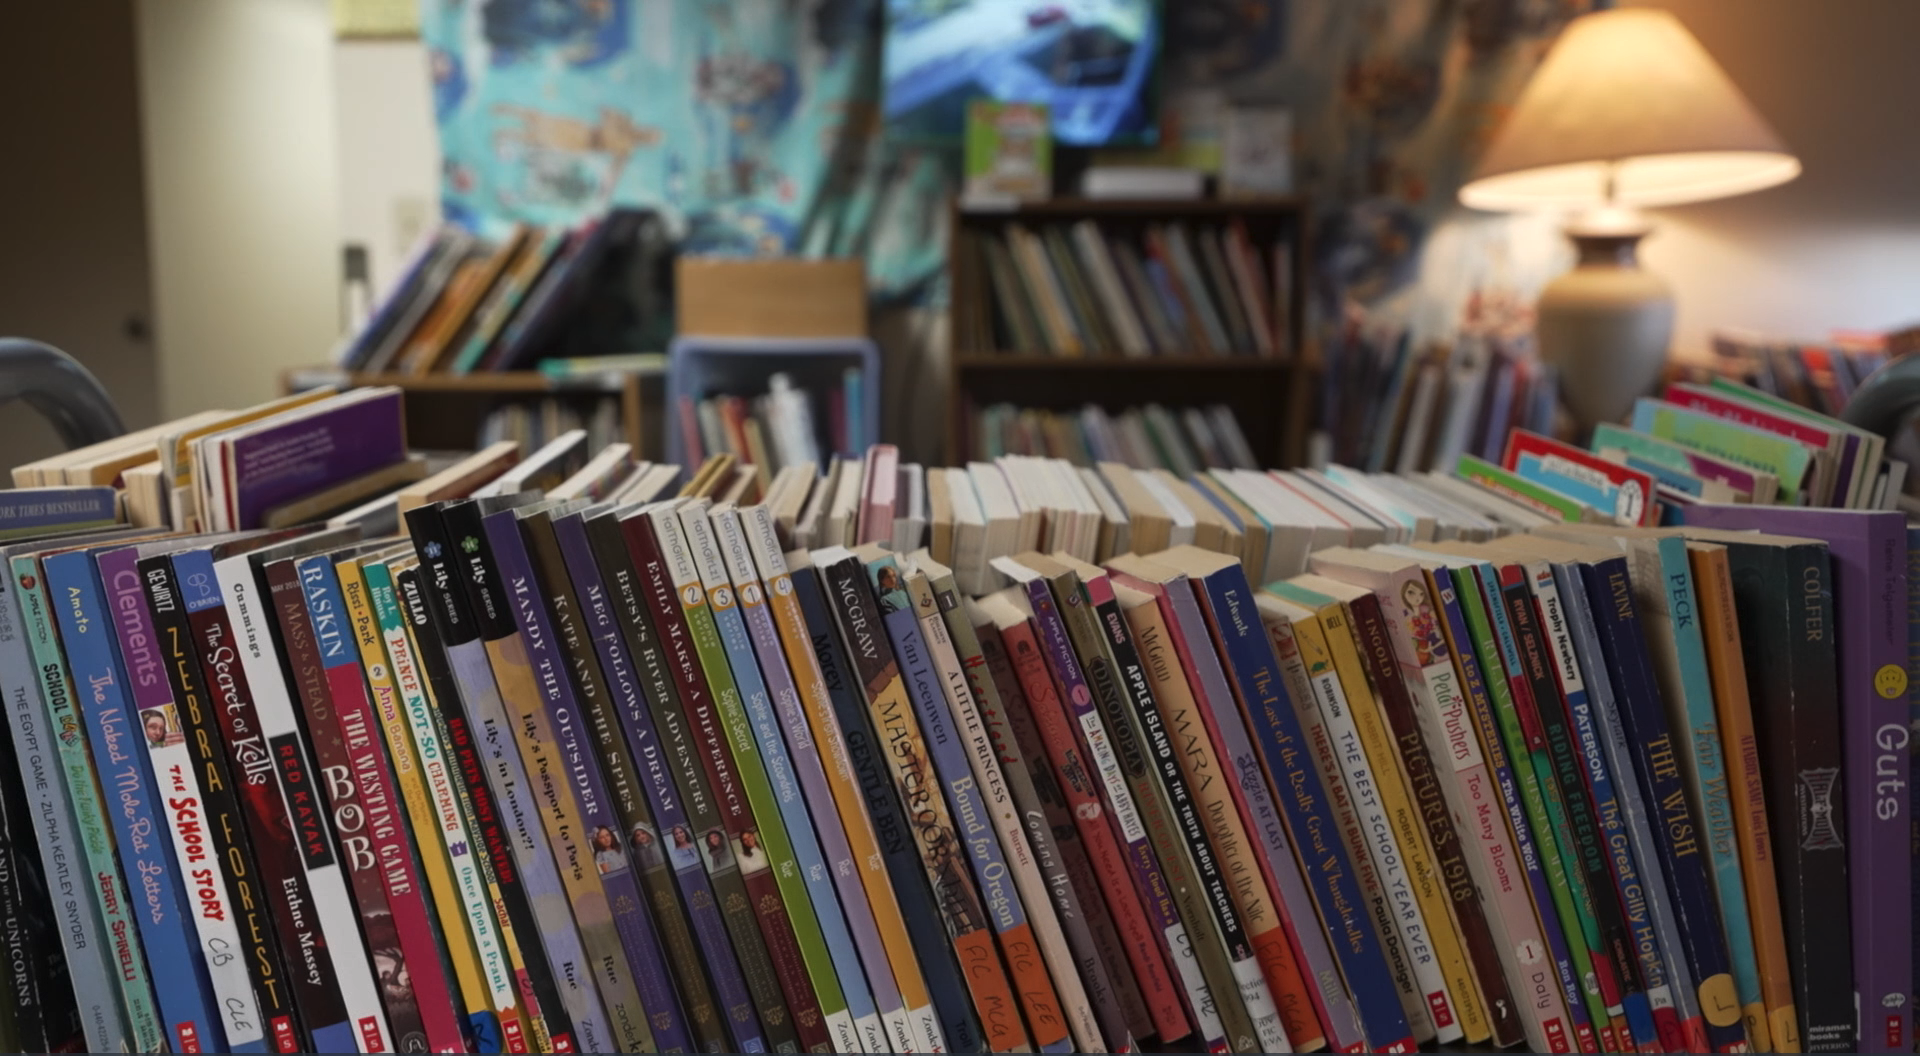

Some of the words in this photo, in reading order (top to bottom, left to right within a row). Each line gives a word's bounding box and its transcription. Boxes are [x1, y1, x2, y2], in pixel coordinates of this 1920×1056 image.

[19, 504, 44, 518] TIMES
[49, 500, 101, 515] BESTSELLER
[147, 569, 175, 613] GEWIRTZ
[433, 563, 448, 590] Lily
[470, 558, 486, 585] Lily
[1609, 572, 1634, 622] LEVINE
[68, 587, 89, 633] Amato
[114, 570, 156, 686] Clements
[233, 583, 261, 658] Cummings
[303, 566, 344, 658] RASKIN
[347, 582, 363, 610] Rissi
[358, 617, 376, 646] Park
[403, 580, 428, 626] ZULLO
[443, 593, 459, 624] SERIES
[481, 588, 496, 620] SERIES
[838, 578, 878, 660] MCGRAW
[1106, 612, 1126, 644] EVANS
[1224, 589, 1248, 638] Edwards
[1326, 616, 1342, 630] BELL
[1670, 572, 1692, 630] PECK
[1803, 566, 1823, 642] COLFER
[812, 634, 844, 692] Morey
[1048, 616, 1064, 644] APPLE
[1059, 645, 1076, 680] FICTION
[1366, 618, 1392, 678] INGOLD
[1548, 597, 1562, 633] Trophy
[1558, 635, 1576, 680] Newbery
[14, 687, 28, 710] THE
[89, 668, 113, 704] The
[512, 576, 546, 651] MANDY
[539, 658, 562, 700] THE
[556, 708, 599, 815] OUTSIDER
[588, 585, 610, 627] MEG
[604, 632, 642, 722] FOLLOWS
[637, 728, 648, 740] A
[644, 746, 674, 812] DREAM
[616, 570, 648, 643] BETSY'S
[644, 648, 670, 704] RIVER
[664, 710, 708, 815] ADVENTURE
[647, 561, 674, 616] EMILY
[668, 623, 696, 683] MAKES
[690, 690, 700, 700] A
[696, 706, 742, 816] DIFFERENCE
[902, 631, 919, 666] Van
[913, 668, 948, 745] Leeuwen
[948, 671, 959, 681] A
[1252, 666, 1269, 697] The
[1322, 678, 1342, 718] ROBINSON
[20, 712, 38, 751] EGYPT
[374, 686, 396, 722] Anna
[390, 725, 412, 772] Banana
[554, 594, 580, 650] KATE
[574, 656, 596, 698] AND
[592, 704, 613, 745] THE
[606, 751, 636, 814] SPIES
[952, 684, 979, 732] LITTLE
[1094, 666, 1144, 770] DINOTOPIA
[1263, 697, 1282, 730] Last
[1432, 672, 1452, 710] Petal
[1443, 706, 1472, 761] Pushers
[1606, 700, 1626, 748] Skylark
[99, 708, 128, 765] Naked
[1171, 708, 1213, 792] MARA
[1274, 731, 1294, 746] of
[1280, 746, 1296, 770] the
[1310, 722, 1336, 776] THERE'S
[1574, 704, 1604, 782] PATERSON
[1694, 721, 1719, 768] Fair
[30, 755, 48, 790] GAME
[169, 765, 186, 792] THE
[848, 730, 885, 812] GENTLE
[878, 816, 904, 855] BEN
[973, 736, 1007, 804] PRINCESS
[1290, 770, 1314, 814] Really
[1328, 773, 1339, 786] A
[1332, 784, 1348, 811] BAT
[1648, 732, 1679, 784] THE
[1664, 789, 1699, 858] WISH
[1876, 723, 1909, 820] Guts
[41, 802, 60, 843] ZILPHA
[115, 766, 151, 854] Mole-Rat
[167, 627, 223, 792] ZEBRA
[220, 814, 279, 1008] FOREST
[280, 745, 302, 783] RED
[293, 791, 324, 856] KAYAK
[321, 765, 376, 872] BOB
[342, 708, 370, 750] THE
[356, 754, 394, 840] WESTING
[380, 844, 412, 896] GAME
[1126, 664, 1152, 708] APPLE
[1144, 710, 1171, 758] ISLAND
[1164, 762, 1176, 778] OR
[1172, 780, 1188, 802] THE
[1181, 804, 1200, 840] TRUTH
[1195, 843, 1216, 876] ABOUT
[1210, 880, 1237, 932] TEACHERS
[1237, 753, 1264, 804] Lizzie
[1258, 804, 1270, 819] AT
[1264, 821, 1284, 851] LAST
[1342, 812, 1353, 826] IN
[1550, 724, 1576, 785] RIDING
[1569, 794, 1602, 872] FREEDOM
[1704, 772, 1732, 857] Weather
[169, 798, 206, 863] SCHOOL
[951, 776, 985, 836] Bound
[968, 838, 990, 862] for
[983, 862, 1015, 928] Oregon
[1009, 828, 1030, 867] Burnett
[1306, 816, 1330, 855] Great
[1340, 730, 1362, 764] THE
[1354, 770, 1376, 808] BEST
[1371, 814, 1394, 876] SCHOOL
[1391, 877, 1416, 920] YEAR
[1406, 923, 1431, 965] EVER
[1348, 826, 1368, 860] BUNK
[1397, 808, 1416, 850] ROBERT
[1412, 854, 1433, 898] LAWSON
[1468, 774, 1481, 800] Too
[1476, 804, 1496, 842] Many
[1490, 844, 1512, 892] Blooms
[52, 846, 73, 896] KEATLEY
[138, 860, 164, 924] Letters
[808, 864, 822, 882] Rue
[838, 858, 851, 878] Rue
[1026, 810, 1054, 868] Coming
[1051, 873, 1074, 920] Home
[1360, 862, 1378, 893] FIVE
[1444, 857, 1472, 901] 1918
[192, 869, 224, 922] STORY
[1322, 856, 1364, 954] Whangdoodles
[66, 902, 86, 950] SNYDER
[98, 872, 120, 915] JERRY
[112, 920, 136, 982] SPINELLI
[282, 877, 304, 928] Eithne
[298, 932, 322, 986] Massey
[1374, 897, 1392, 934] Paula
[1388, 936, 1414, 994] Danziger
[6, 918, 31, 1006] UNICORNS
[563, 962, 578, 990] Rue
[603, 955, 618, 986] Rue
[1009, 942, 1033, 973] FIC
[1024, 991, 1058, 1026] LEE
[1319, 970, 1342, 1006] Mills
[1532, 972, 1552, 1009] Daly
[956, 1020, 972, 1048] Troll
[1810, 1024, 1851, 1034] miramax
[1810, 1032, 1840, 1041] books
